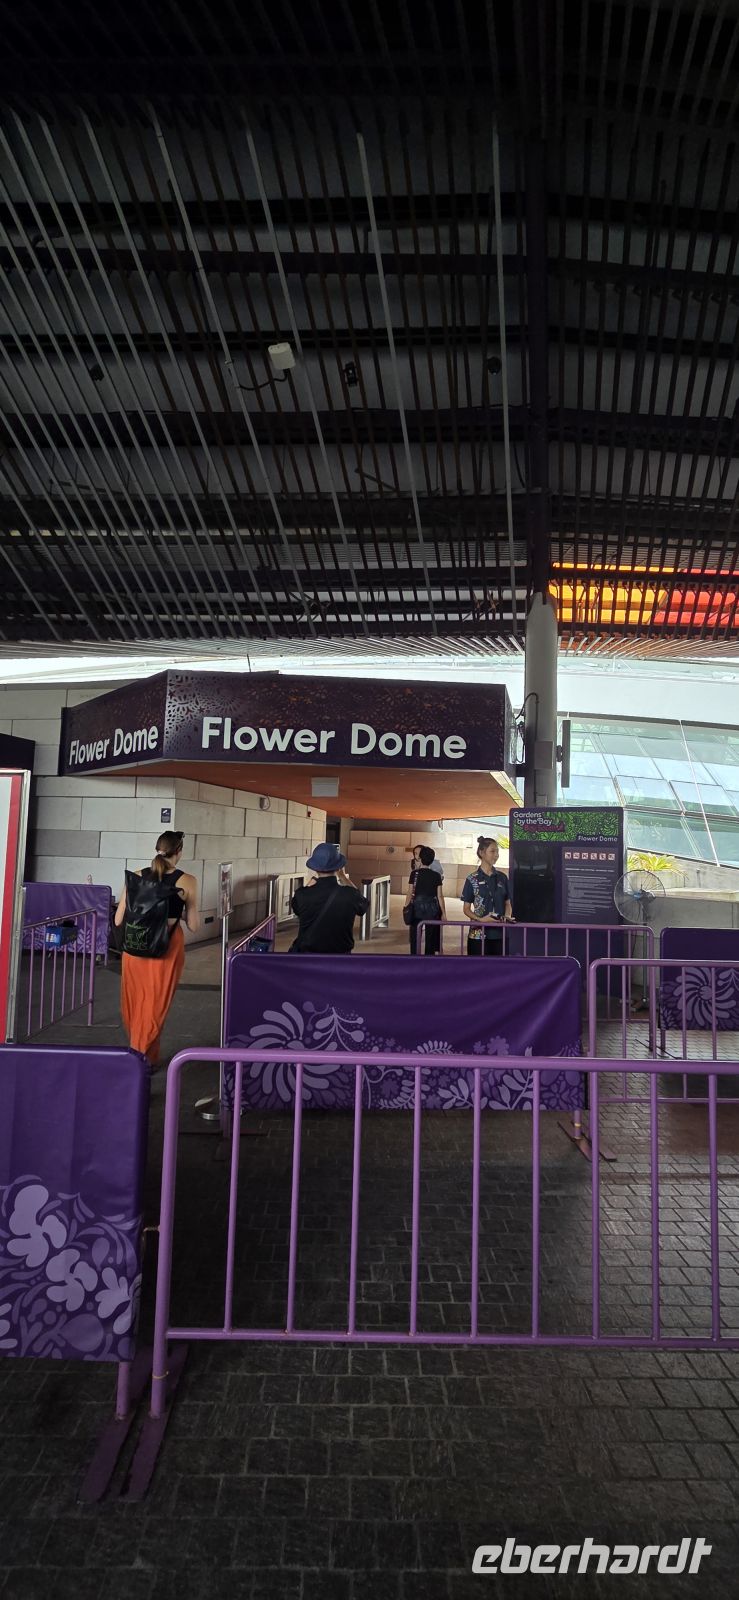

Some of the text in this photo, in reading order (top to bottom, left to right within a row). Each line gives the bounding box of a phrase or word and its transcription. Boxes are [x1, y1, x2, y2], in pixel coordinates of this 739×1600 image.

[69, 725, 159, 766] Flower Dome
[201, 716, 466, 759] Flower Dome
[517, 818, 526, 826] by
[537, 818, 552, 826] Bay
